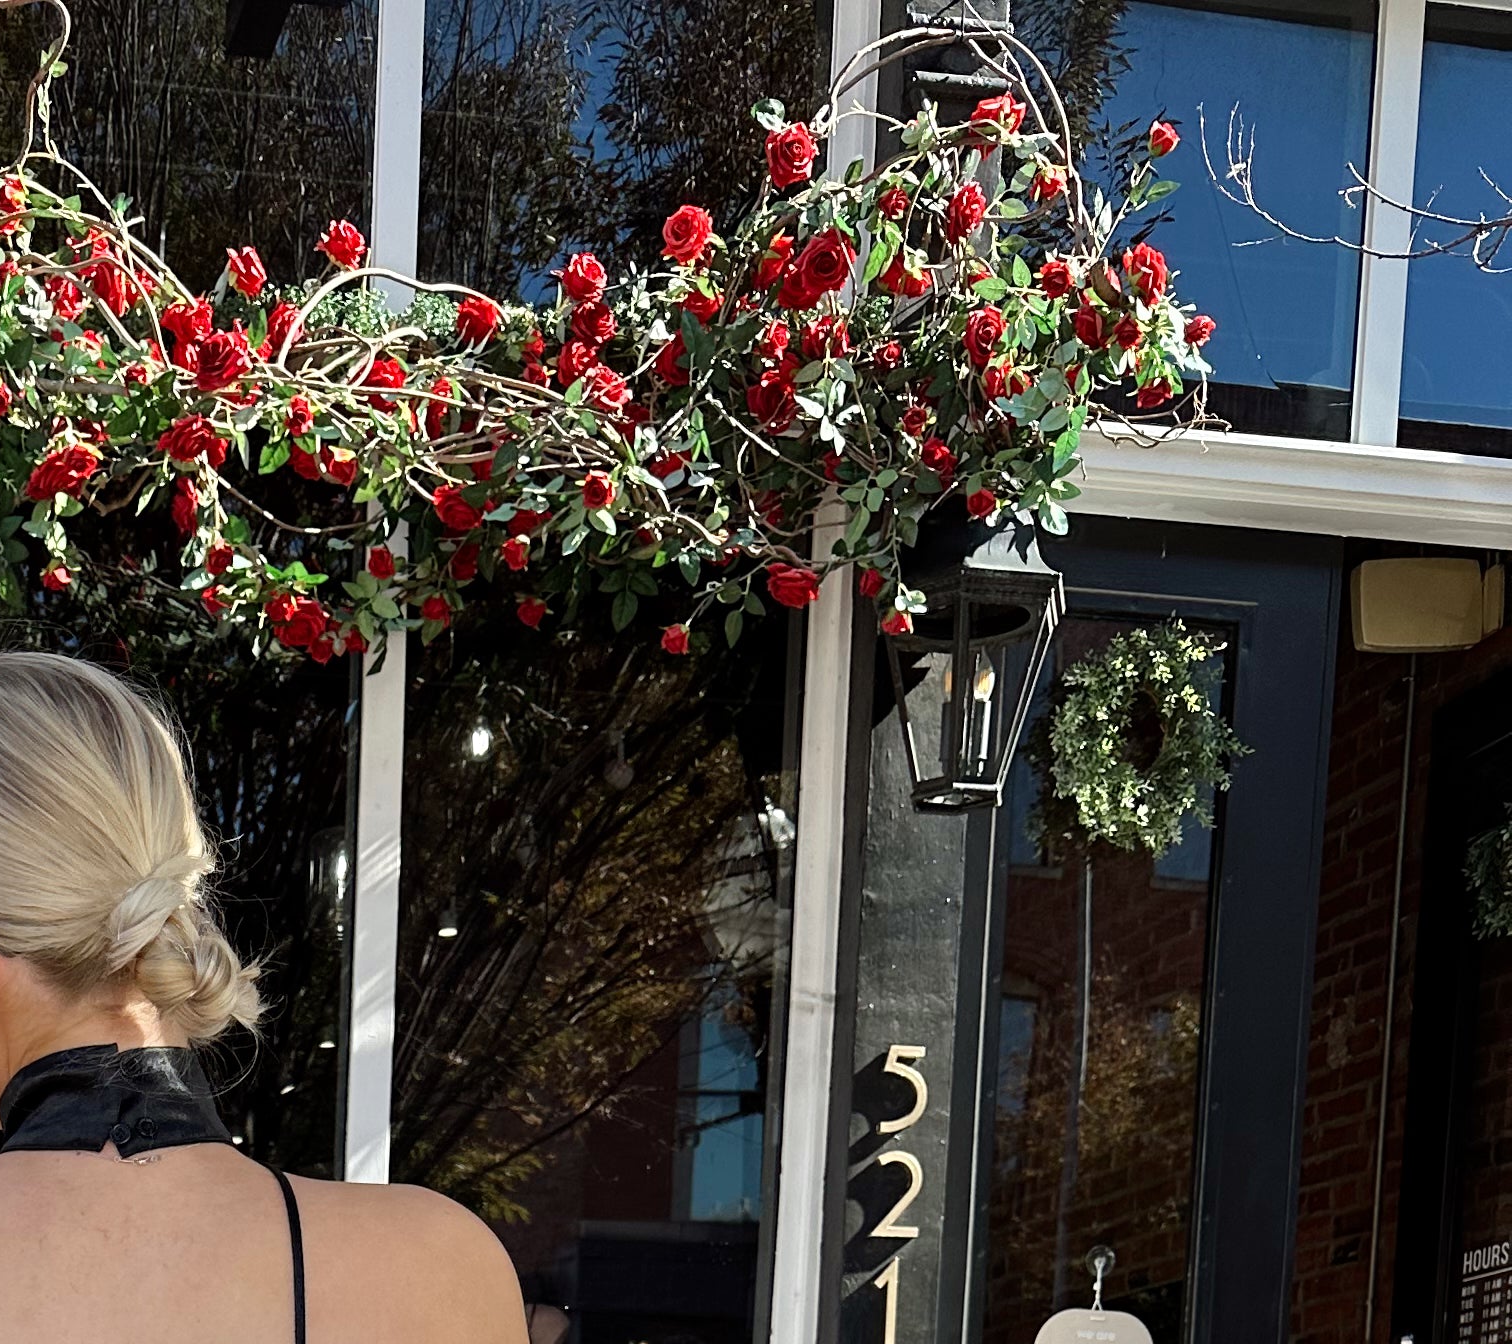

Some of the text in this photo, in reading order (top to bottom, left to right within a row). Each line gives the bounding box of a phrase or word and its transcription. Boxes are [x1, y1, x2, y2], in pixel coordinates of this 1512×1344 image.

[1463, 1242, 1510, 1275] HOURS
[1077, 1330, 1117, 1342] we are
